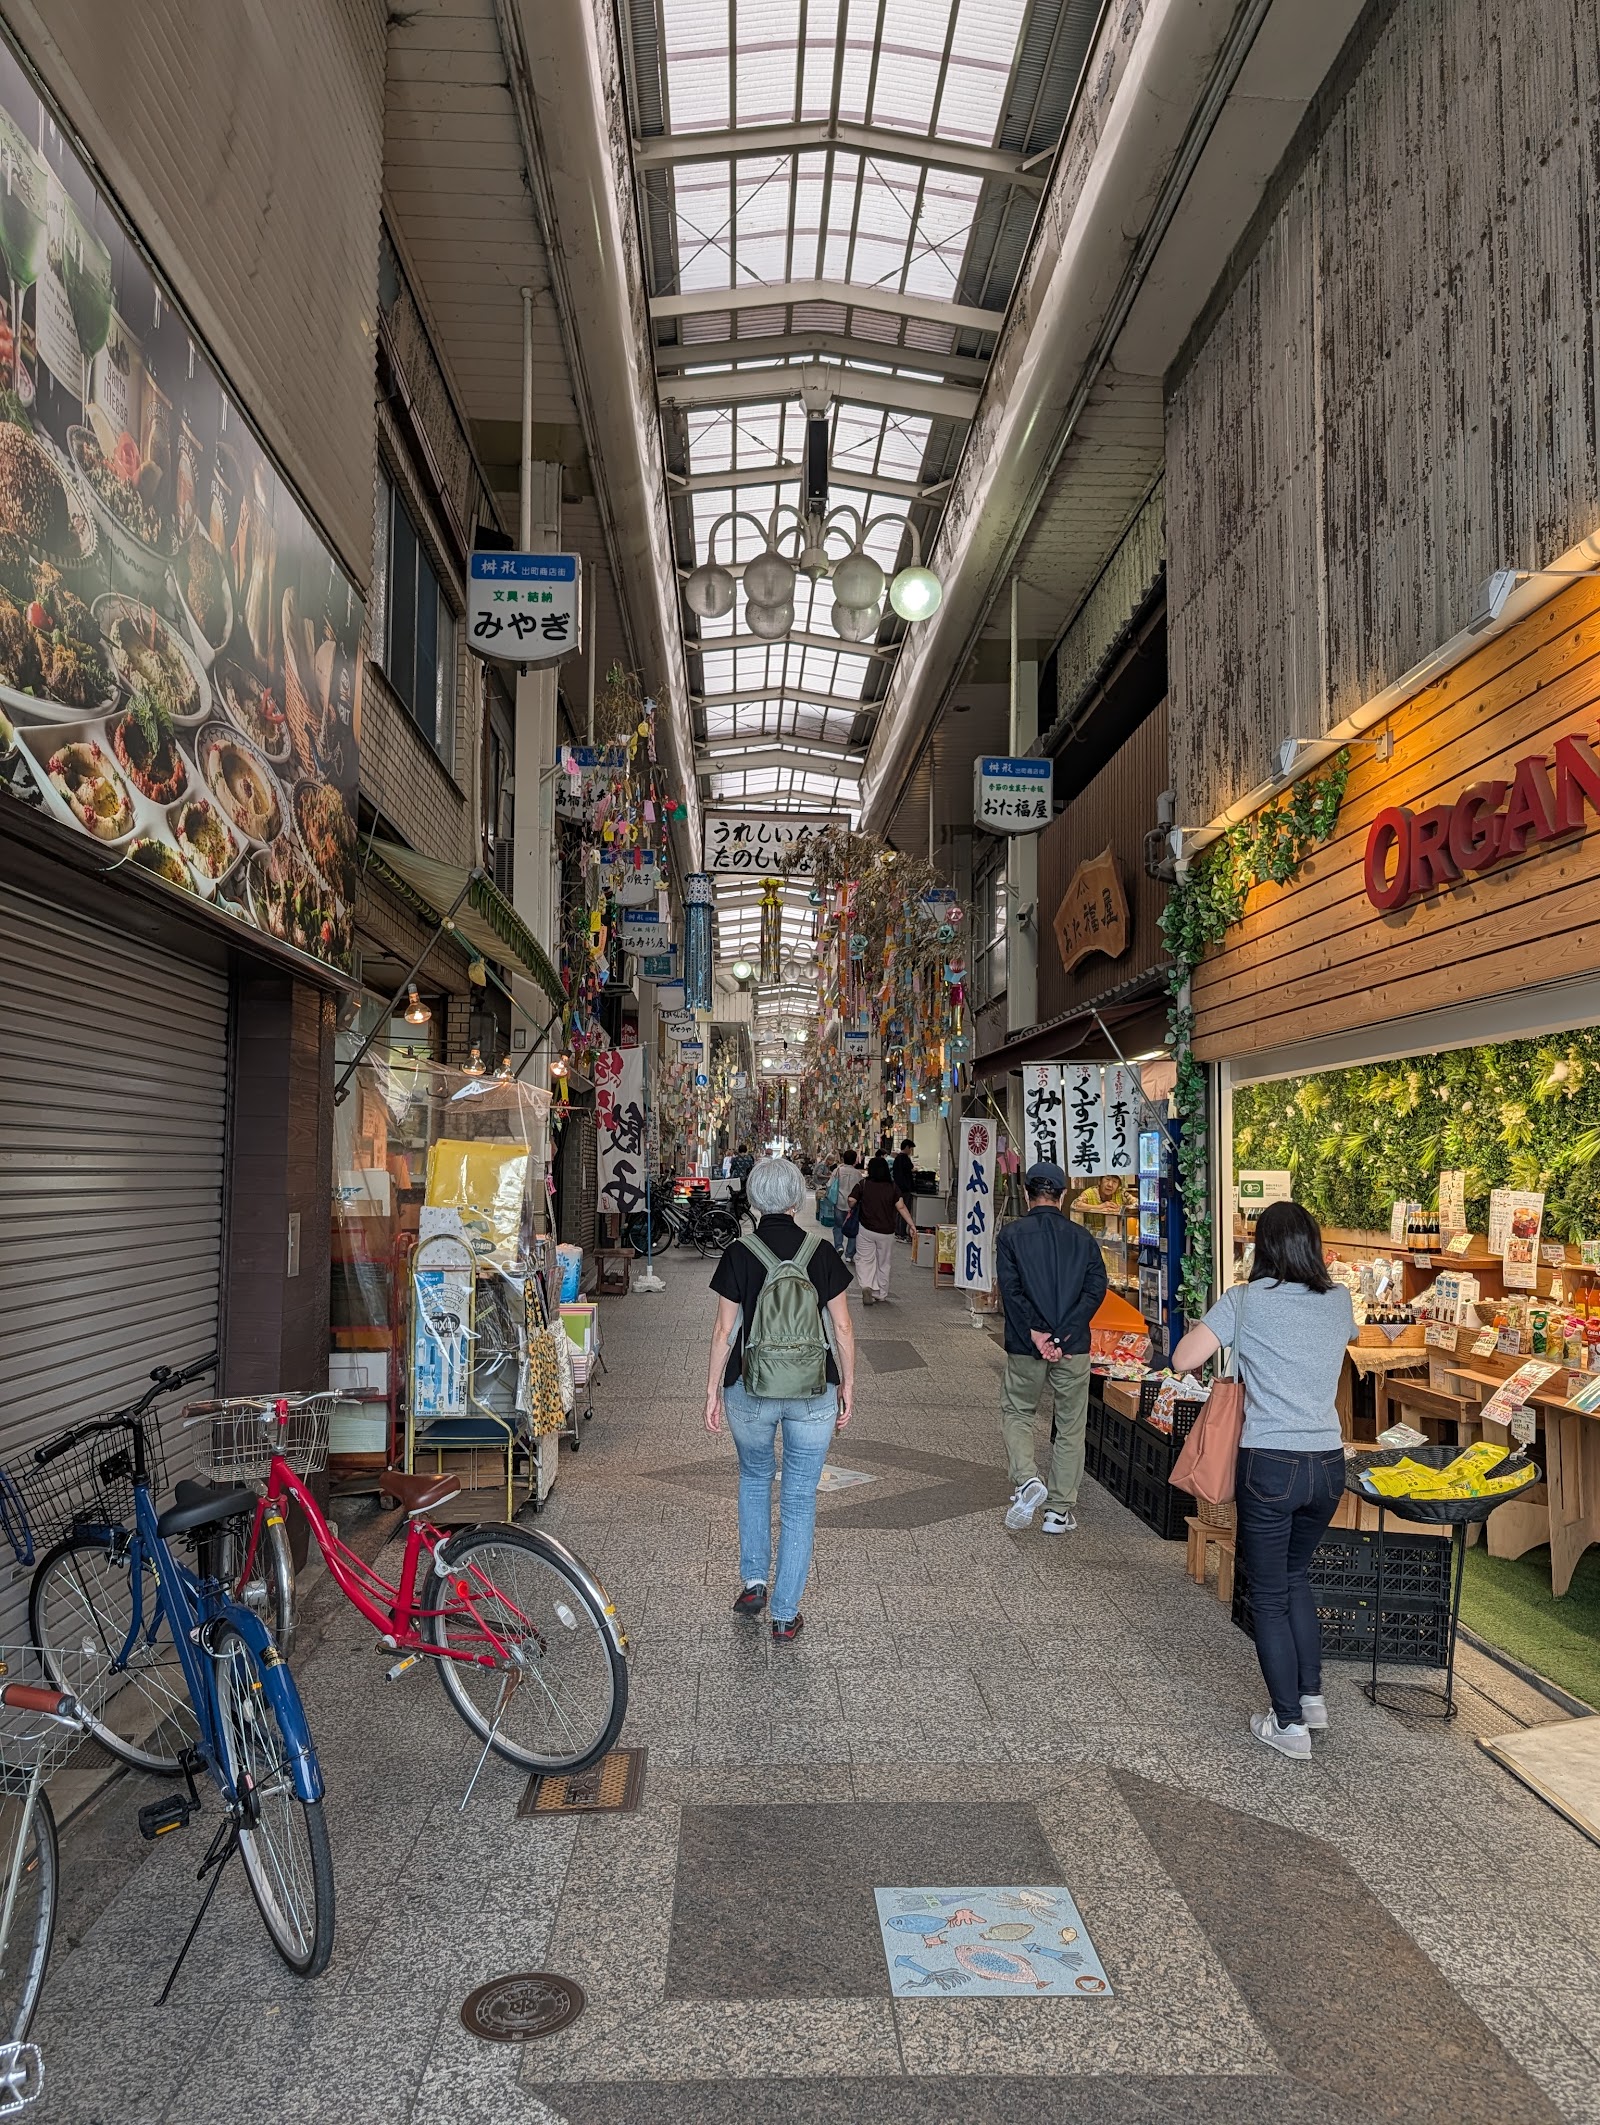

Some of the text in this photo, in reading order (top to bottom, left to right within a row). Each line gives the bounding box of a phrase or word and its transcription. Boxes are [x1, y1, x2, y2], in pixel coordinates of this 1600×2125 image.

[54, 305, 65, 325] Dry
[521, 566, 566, 577] 出町商店街
[473, 611, 571, 640] みやぎ
[983, 798, 1049, 819] おた福屋
[1070, 1076, 1101, 1174] くず万寿
[1107, 1101, 1131, 1168] 青うめ
